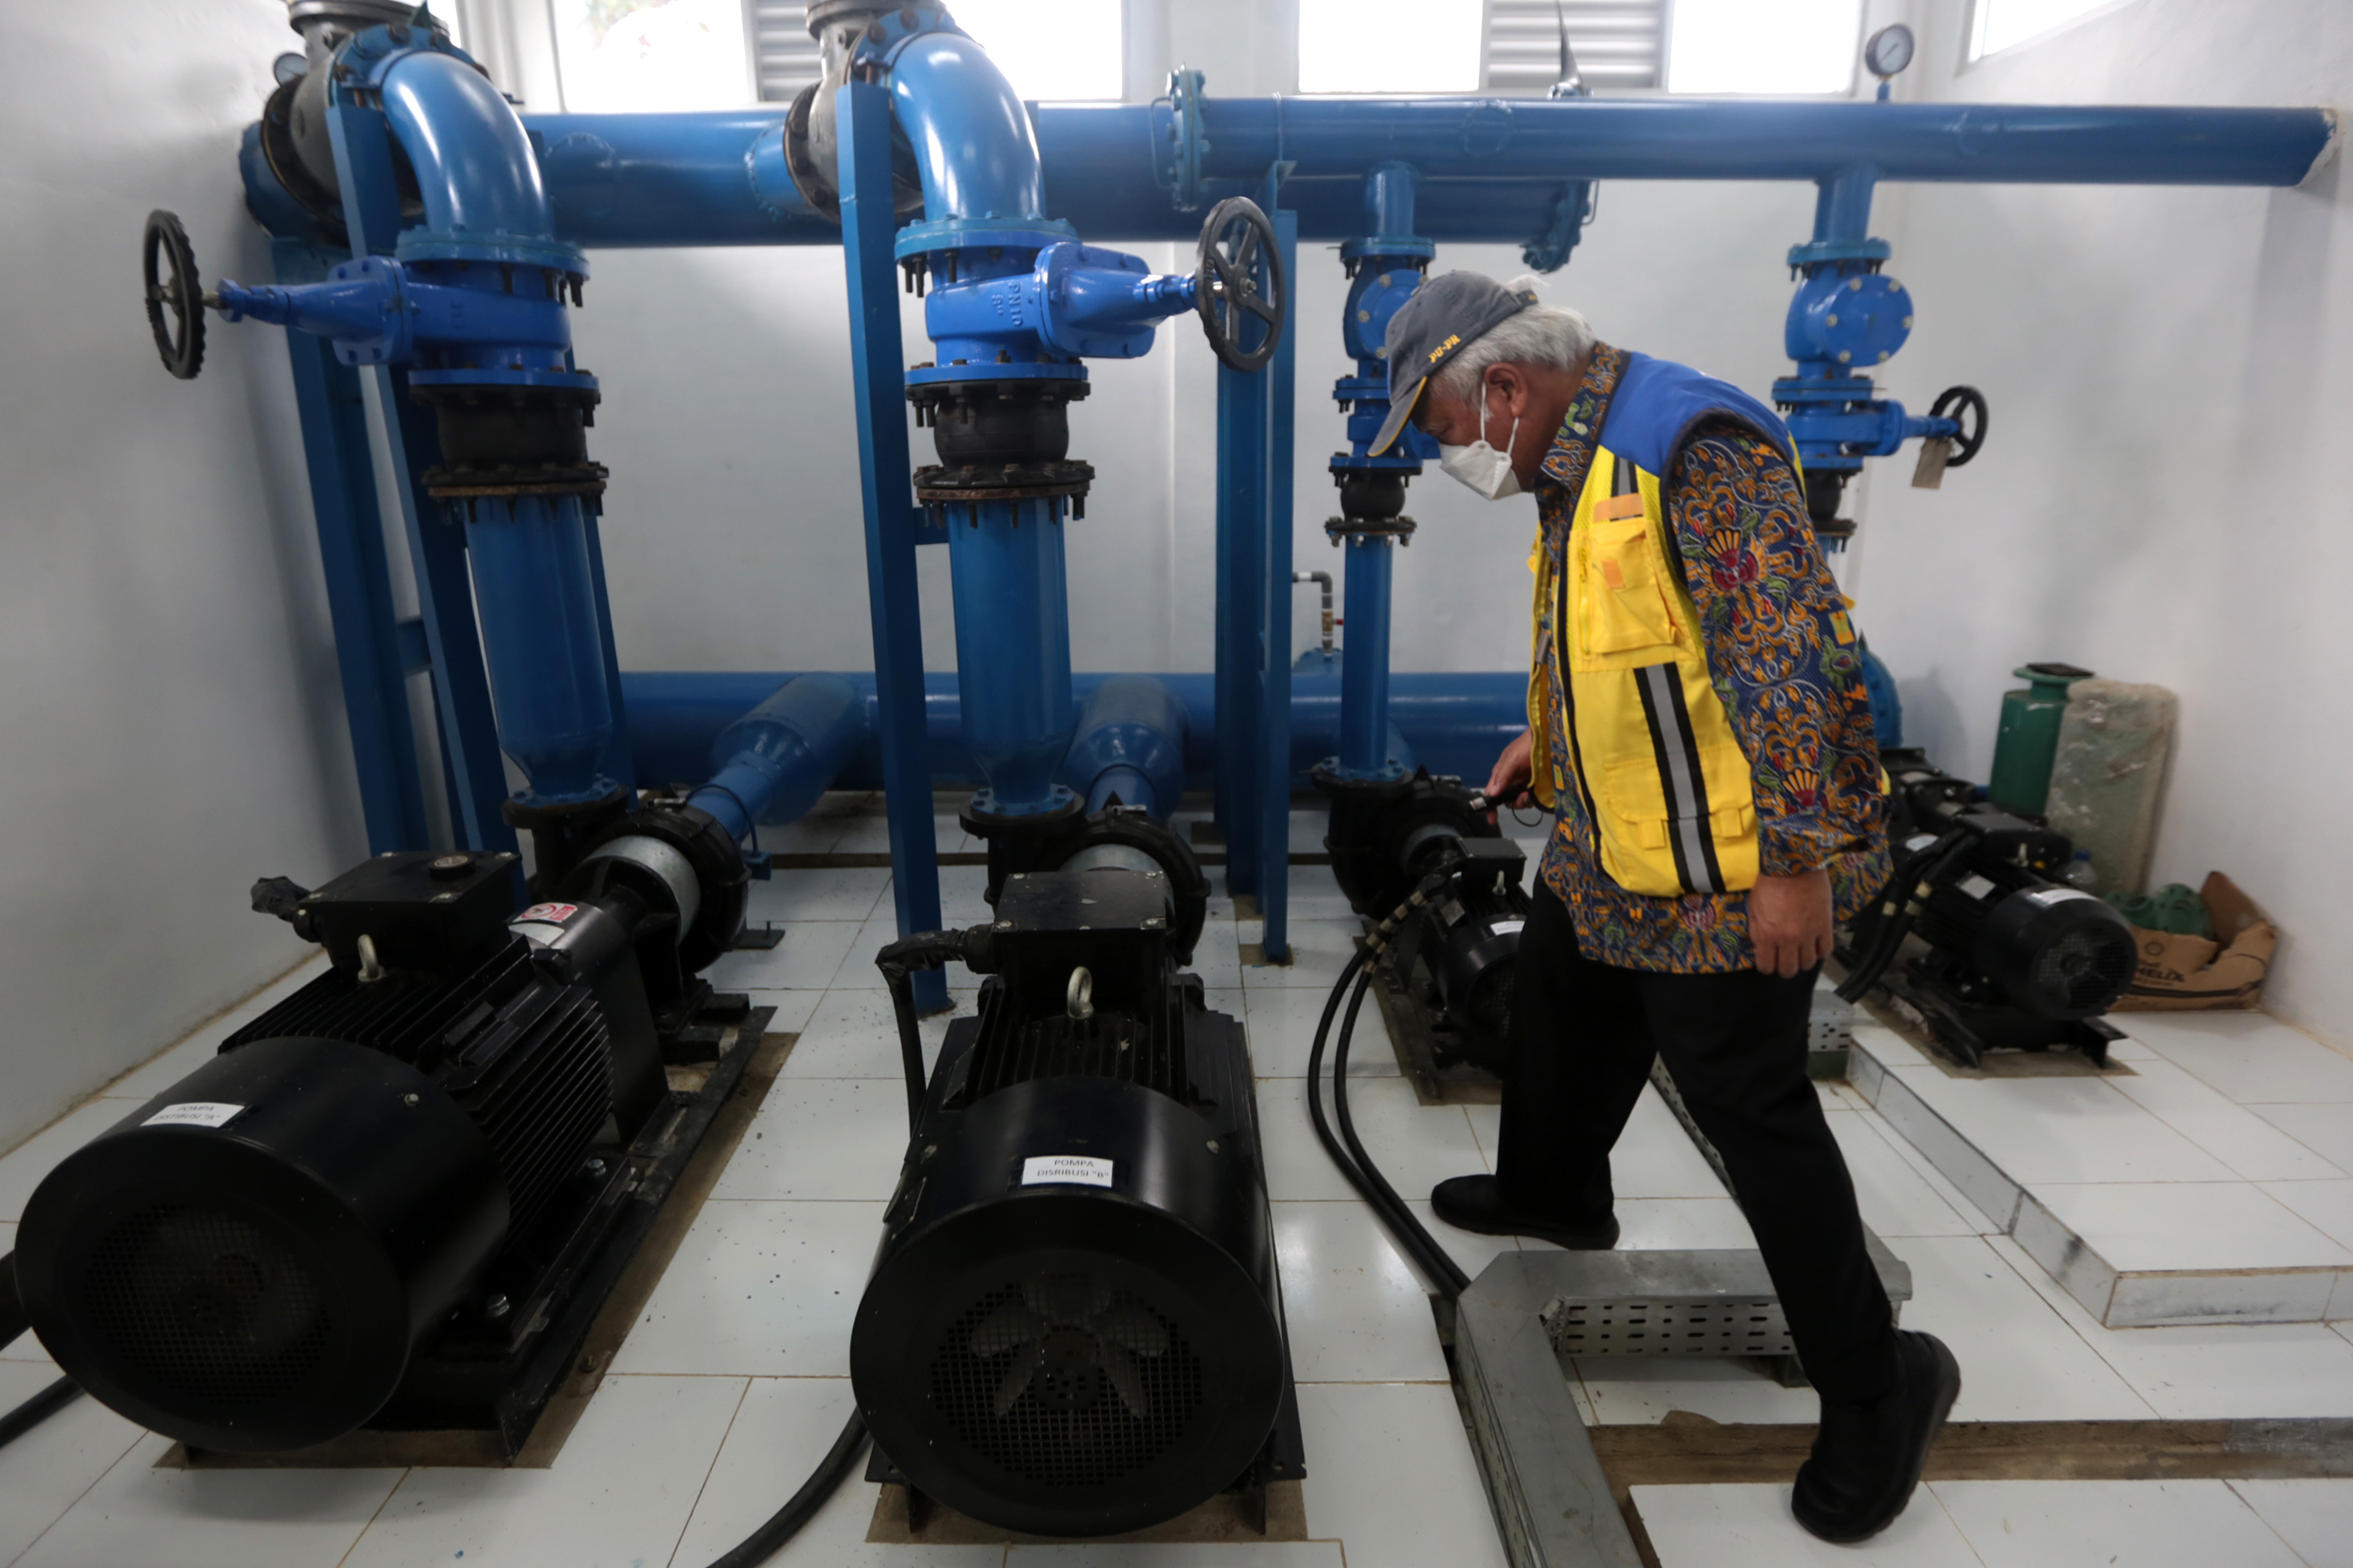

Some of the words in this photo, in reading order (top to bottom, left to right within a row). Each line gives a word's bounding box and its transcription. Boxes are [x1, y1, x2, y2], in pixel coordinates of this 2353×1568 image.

[1008, 281, 1024, 326] PN10
[1428, 334, 1461, 363] PU-PR
[1037, 1169, 1089, 1177] DISRIBUSI
[1092, 1170, 1109, 1178] "B"
